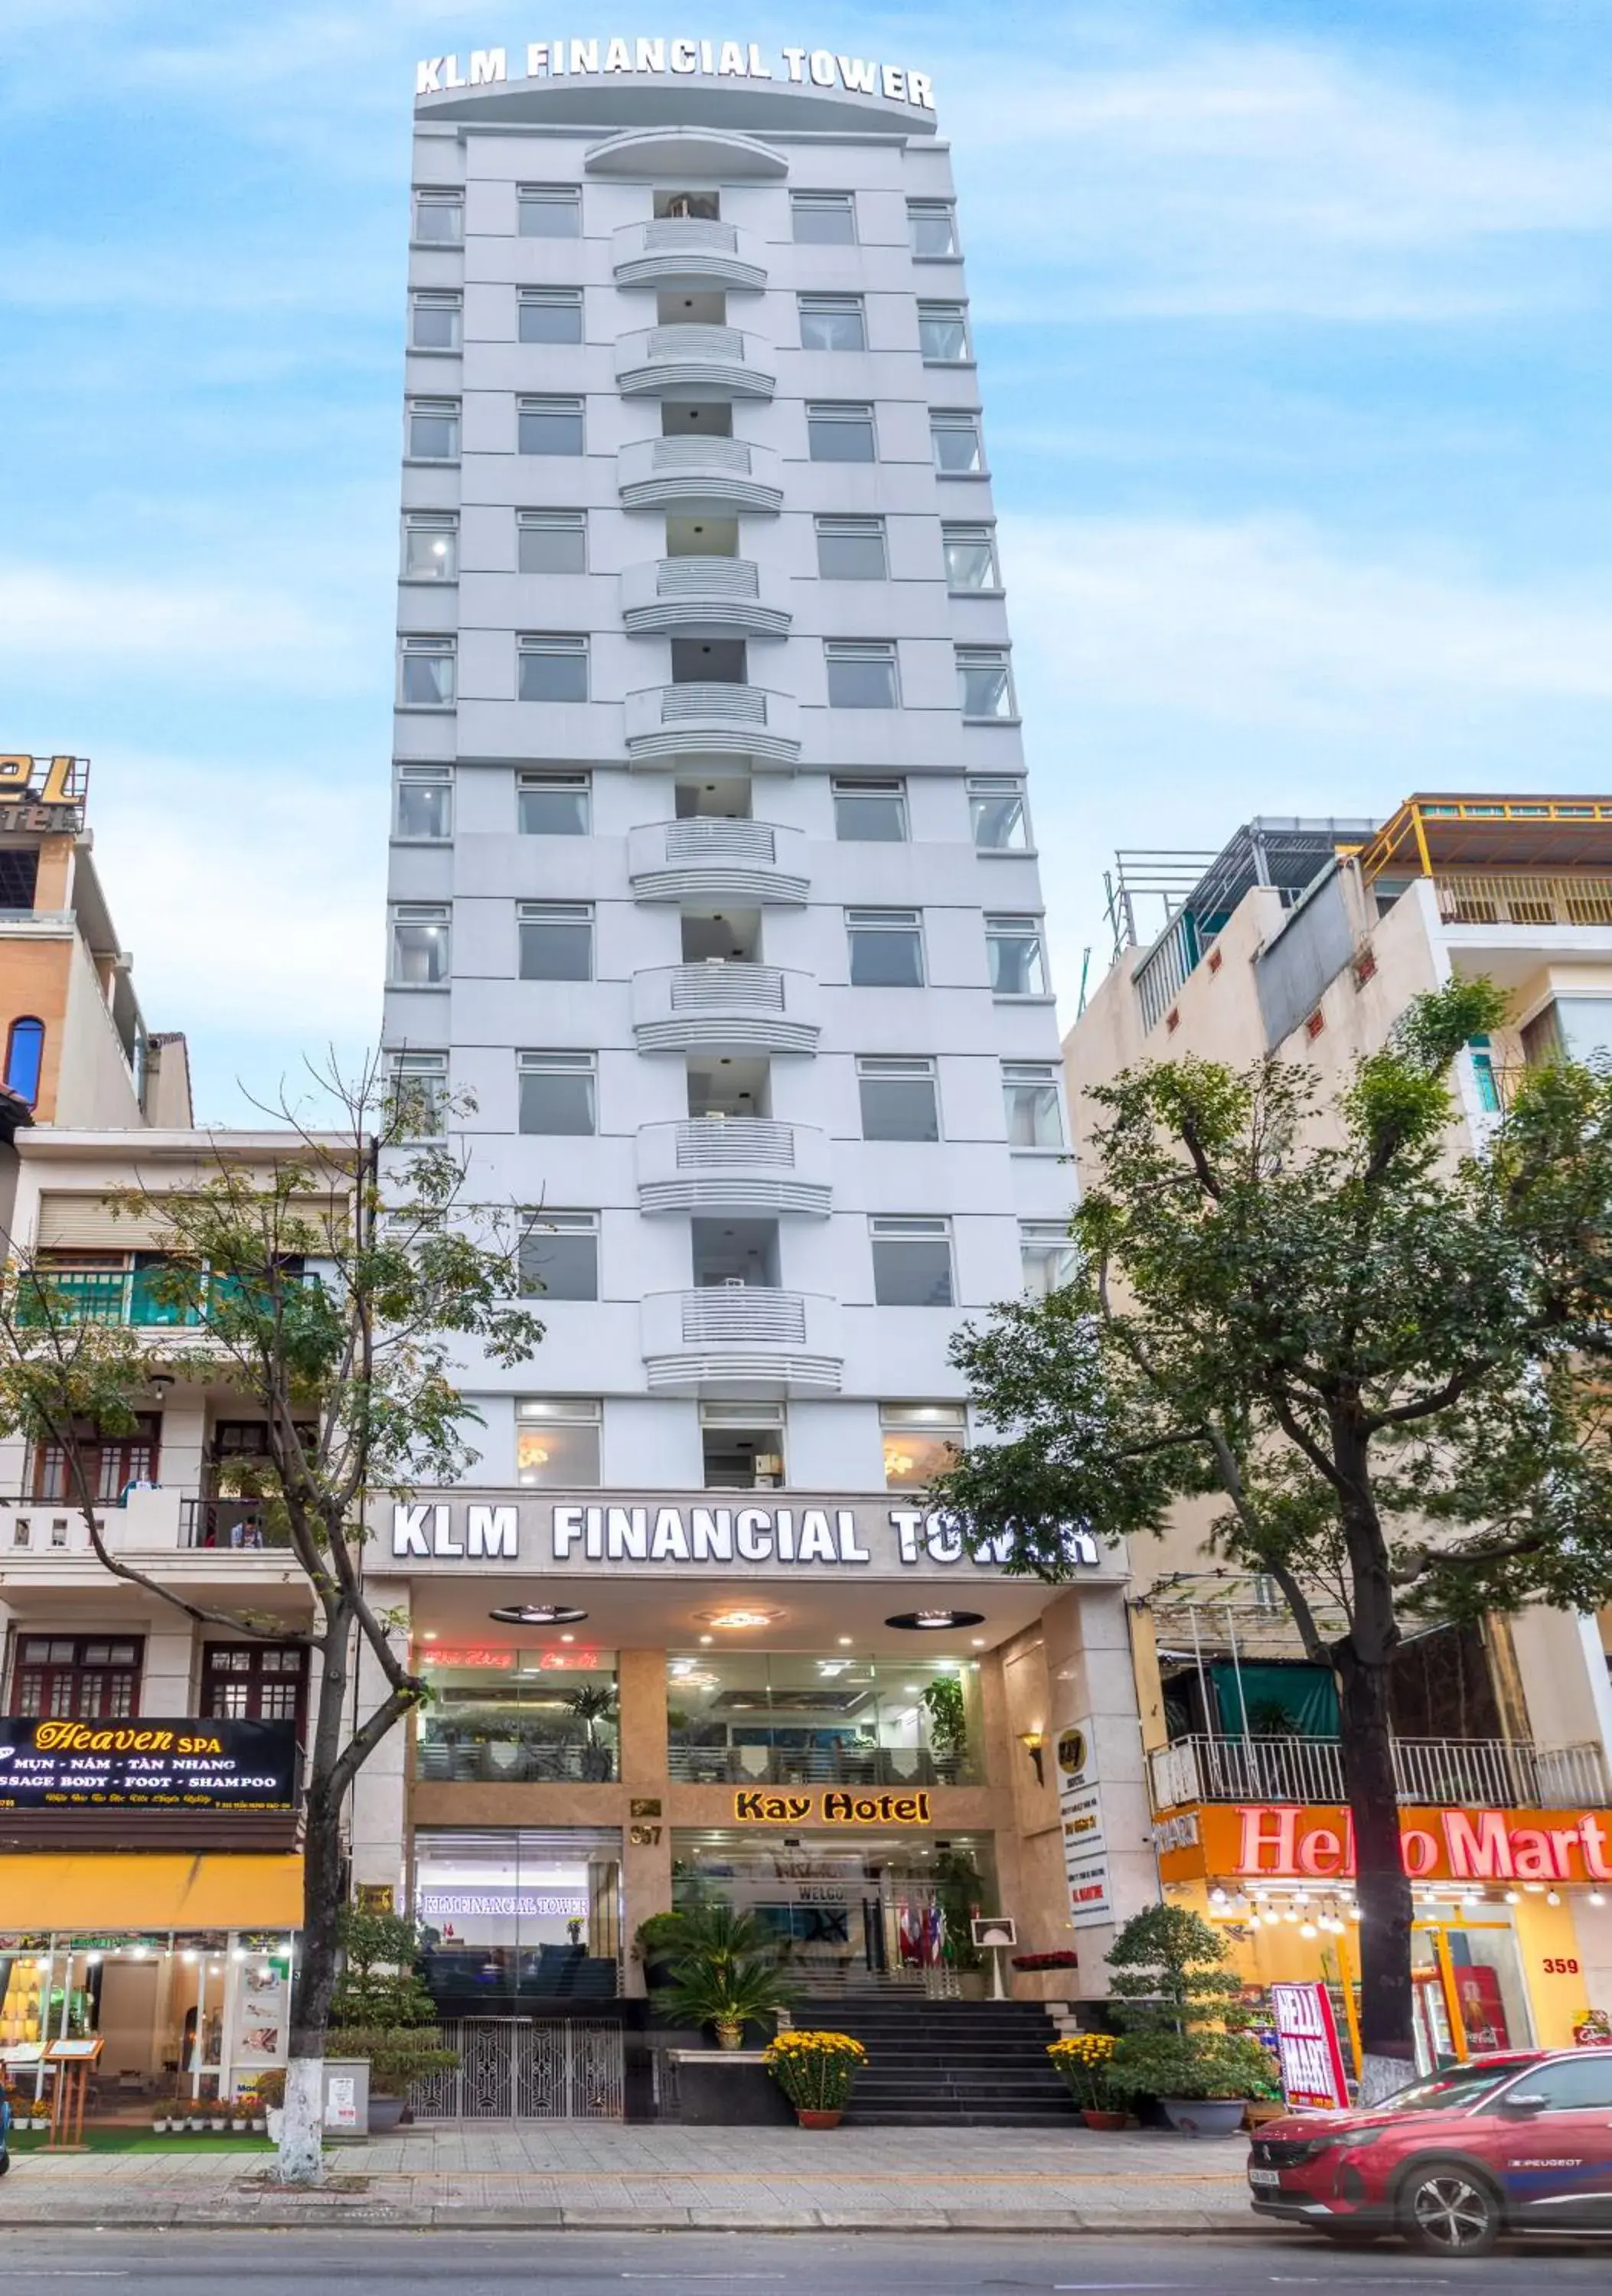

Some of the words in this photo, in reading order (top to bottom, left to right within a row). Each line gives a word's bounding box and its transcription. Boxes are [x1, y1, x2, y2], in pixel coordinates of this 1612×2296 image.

[416, 47, 506, 95] KLM
[527, 38, 772, 79] FINANCIAL
[782, 47, 935, 109] TOWER
[392, 1504, 520, 1557] KLM
[552, 1506, 870, 1563] FINANCIAL
[35, 1721, 175, 1751] Heaven
[177, 1737, 222, 1753] SPA
[172, 1760, 237, 1770] NHANG
[60, 1776, 109, 1787] BODY
[124, 1776, 172, 1787] FOOT
[188, 1777, 277, 1788] SHAMPOO
[736, 1791, 811, 1821] Kay
[823, 1792, 932, 1823] Hotel
[1232, 1805, 1439, 1878] Helo
[1441, 1808, 1612, 1880] Mart
[426, 1896, 458, 1913] KLM
[460, 1896, 536, 1913] FINANCIAL
[538, 1896, 588, 1913] TOWER
[1542, 1958, 1579, 1974] 359
[1278, 1989, 1323, 2035] HELLO
[1524, 2158, 1585, 2167] PEUGEOT
